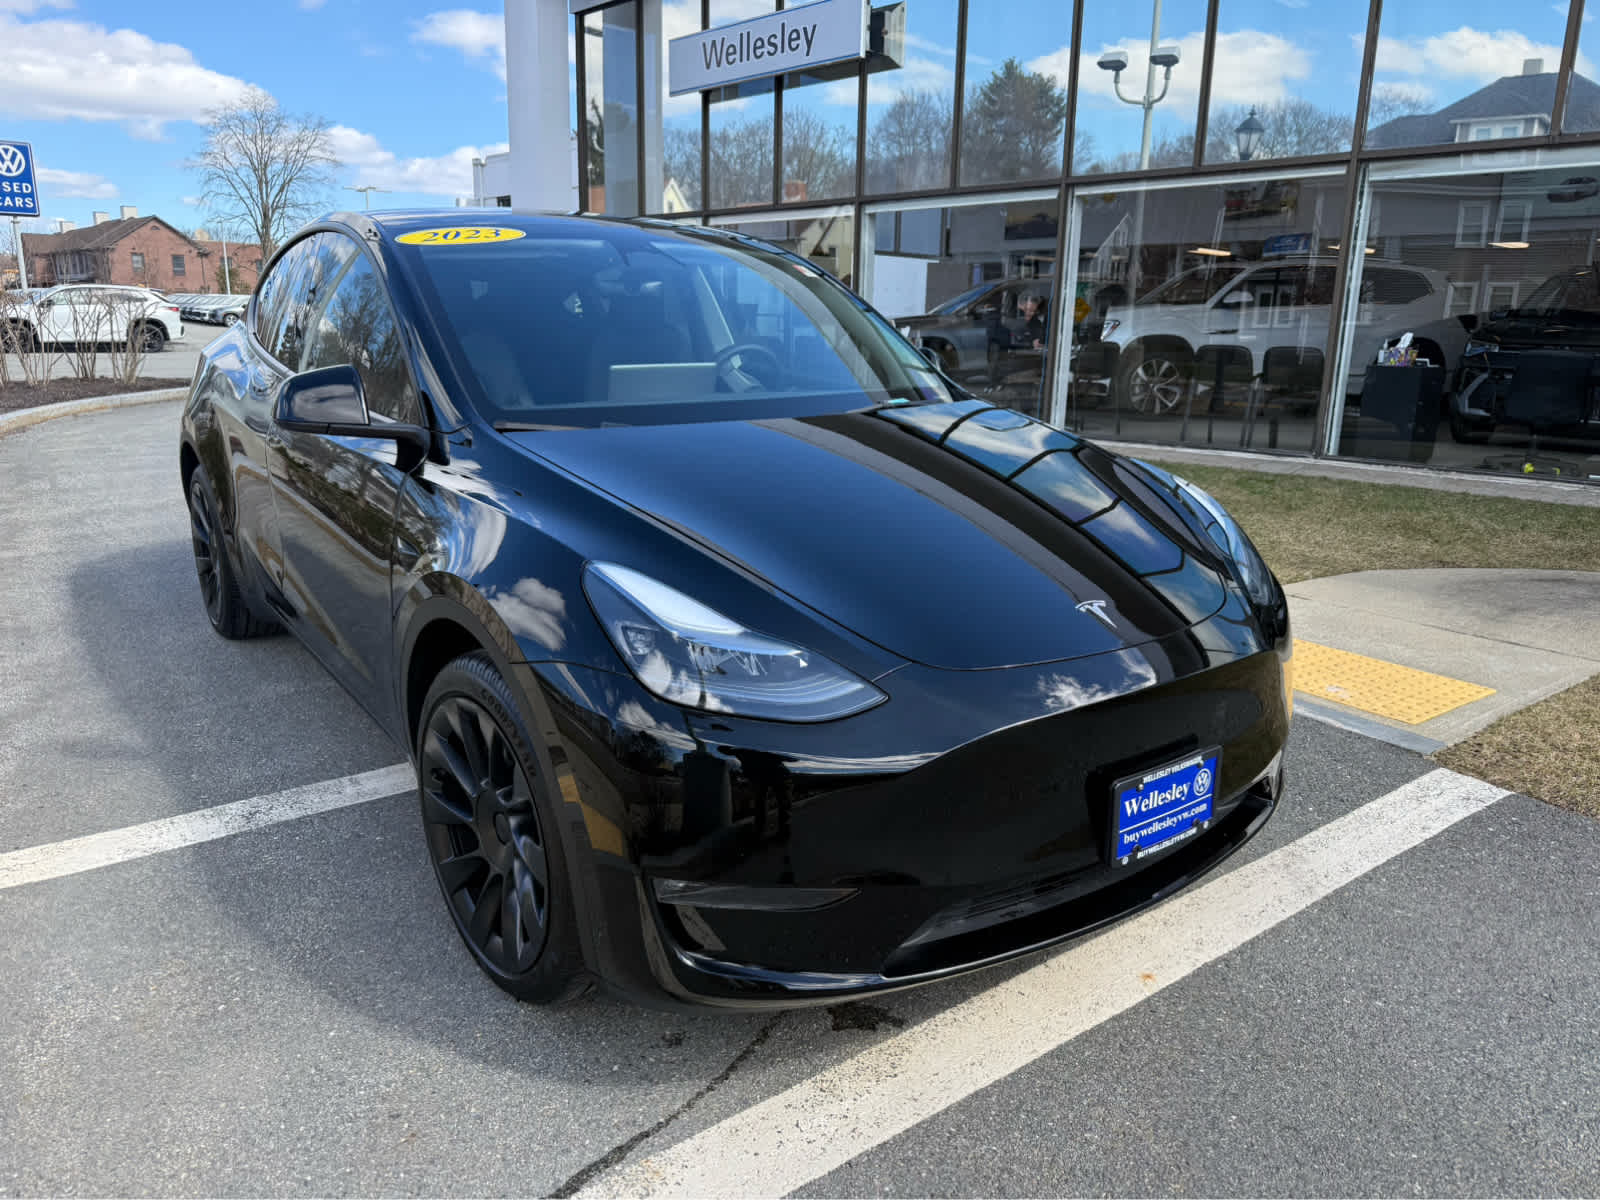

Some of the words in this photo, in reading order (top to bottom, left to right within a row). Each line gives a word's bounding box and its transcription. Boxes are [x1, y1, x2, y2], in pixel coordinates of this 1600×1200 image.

[702, 22, 818, 71] Wellesley
[0, 181, 32, 194] SED
[423, 229, 501, 242] 2023
[1124, 782, 1191, 817] Wellesley
[1123, 803, 1208, 845] buywellesleyvw.com
